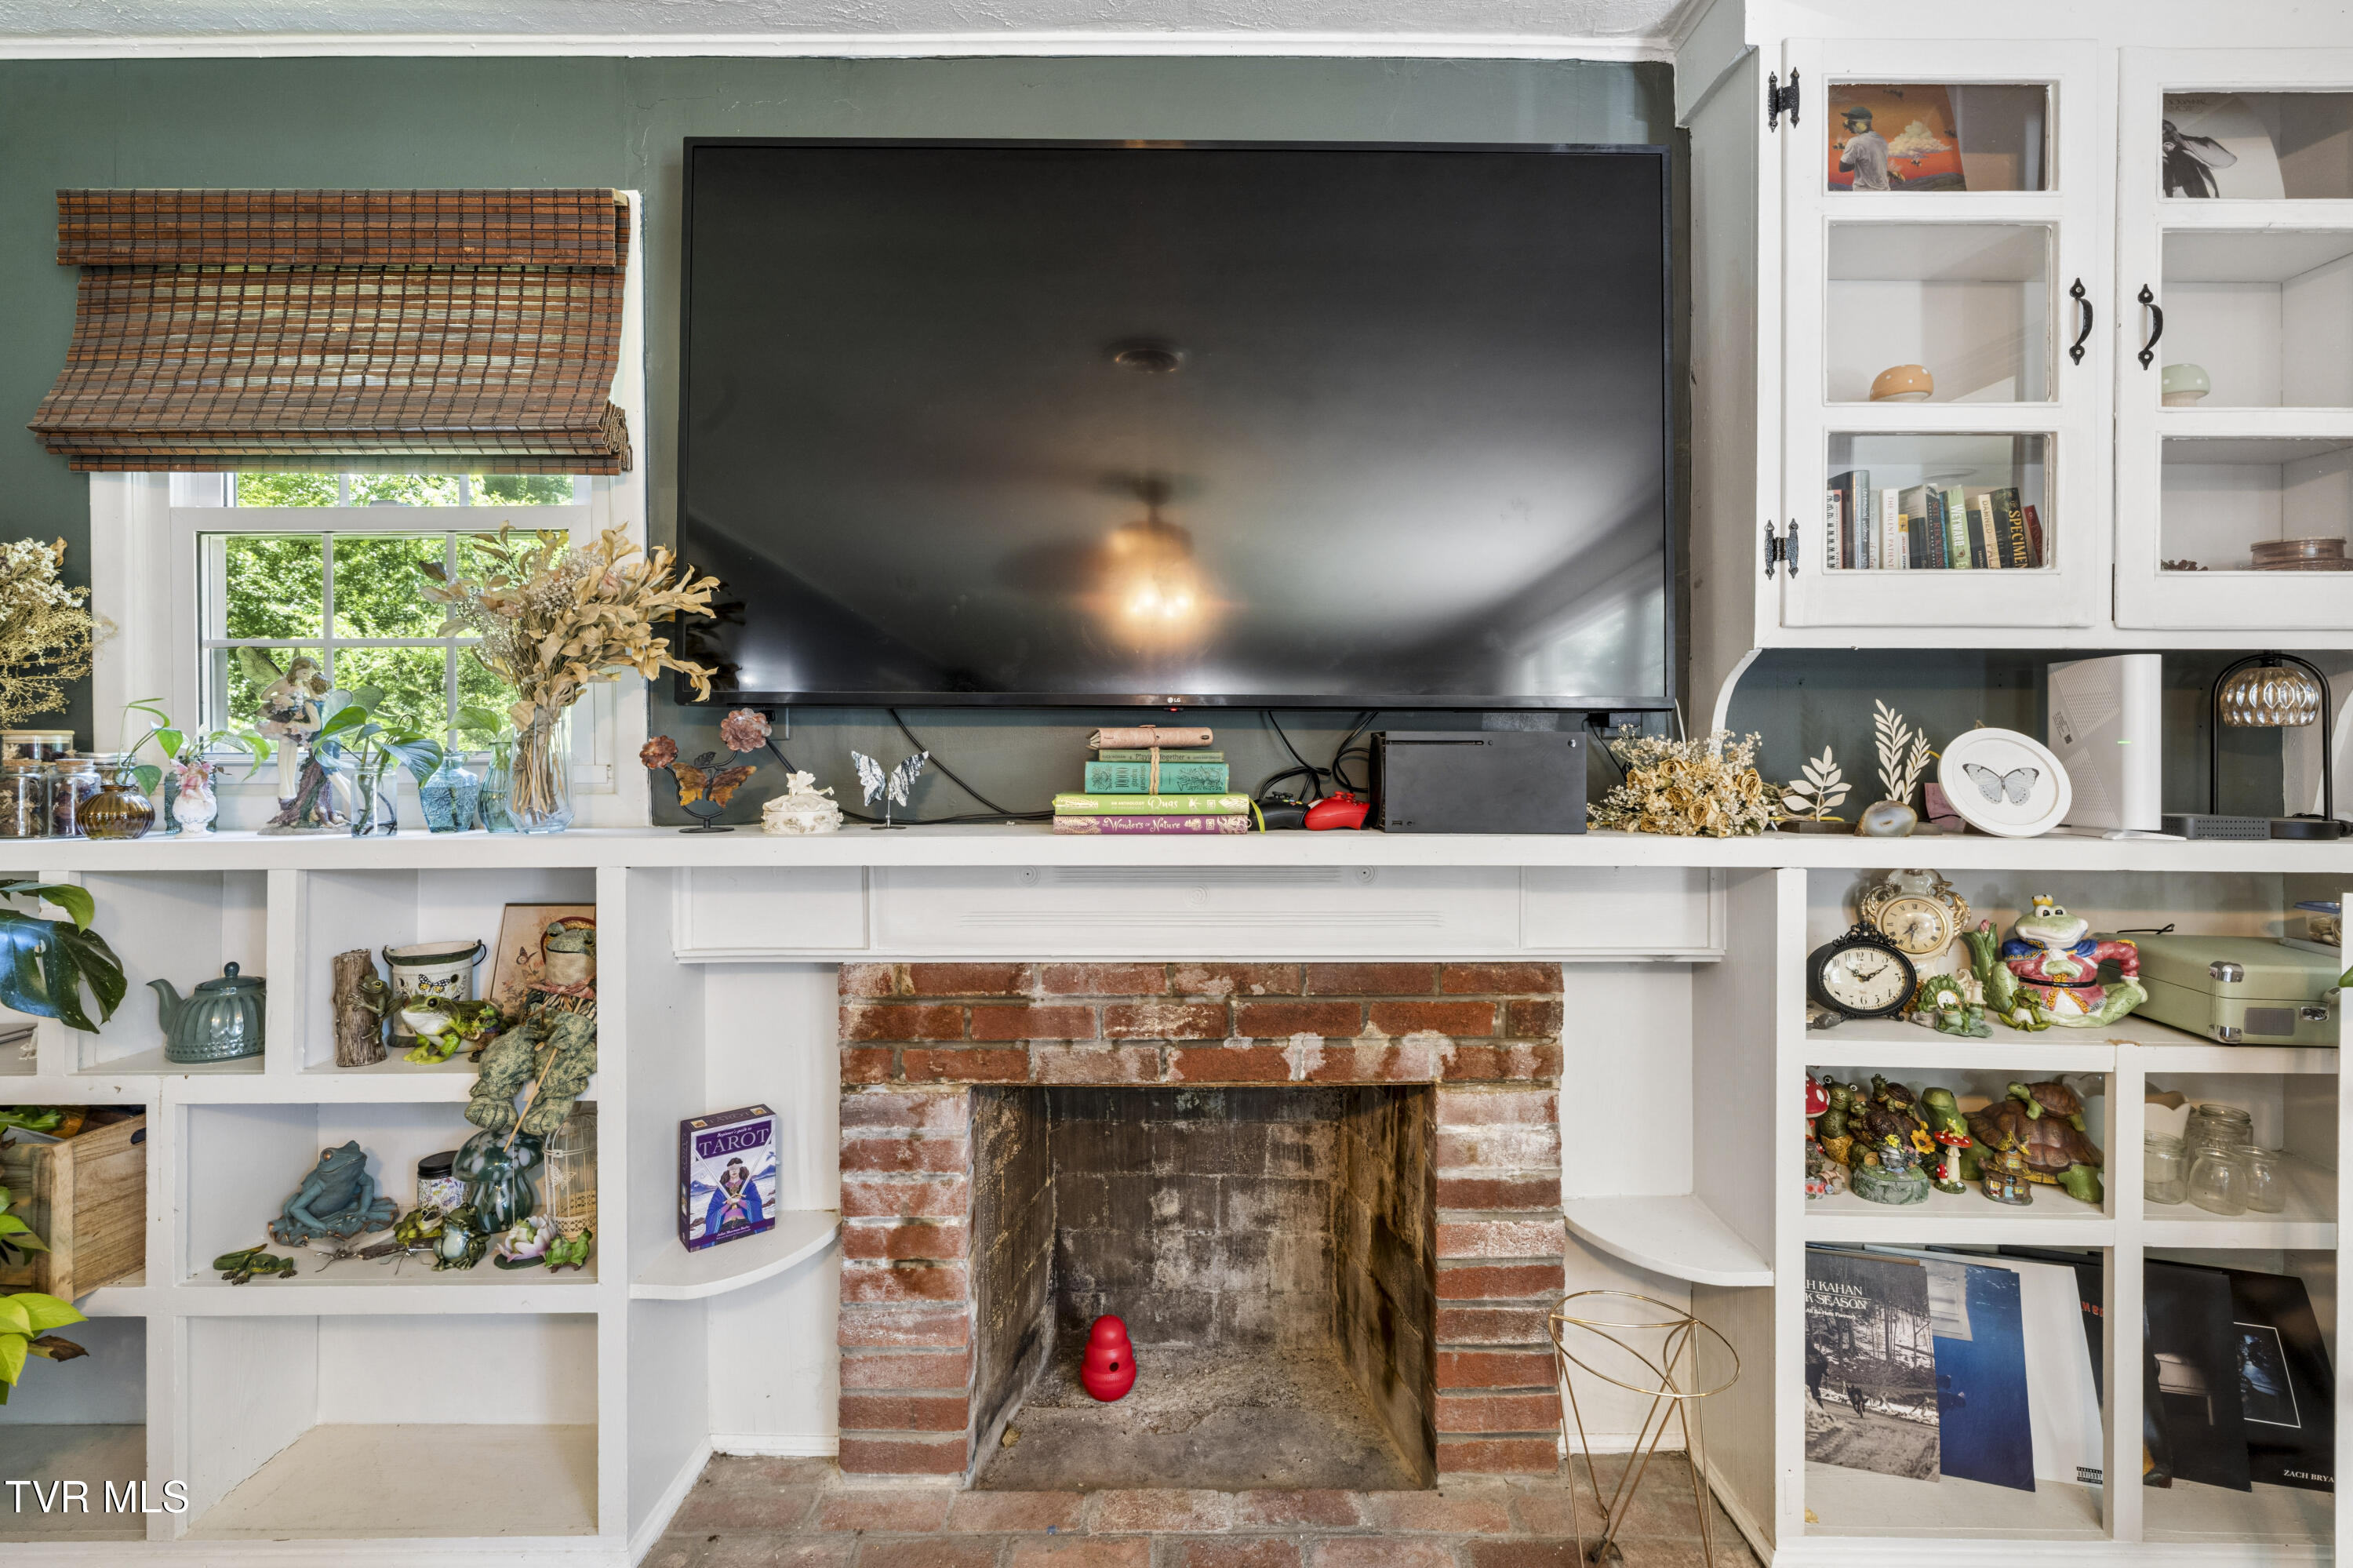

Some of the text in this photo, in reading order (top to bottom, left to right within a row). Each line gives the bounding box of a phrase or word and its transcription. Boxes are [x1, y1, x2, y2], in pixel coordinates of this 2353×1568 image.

[1982, 500, 1993, 534] DAMNED
[1951, 504, 1965, 547] WEYWARD
[1933, 522, 1944, 566] RECKLESS
[1104, 817, 1144, 832] Wonders
[1149, 817, 1180, 832] Nature
[699, 1128, 769, 1157] TAROT
[1819, 1281, 1863, 1296] KAHAN
[1815, 1294, 1867, 1310] SEASON
[2078, 1471, 2102, 1480] ADVISORY
[2283, 1469, 2308, 1479] ZACH
